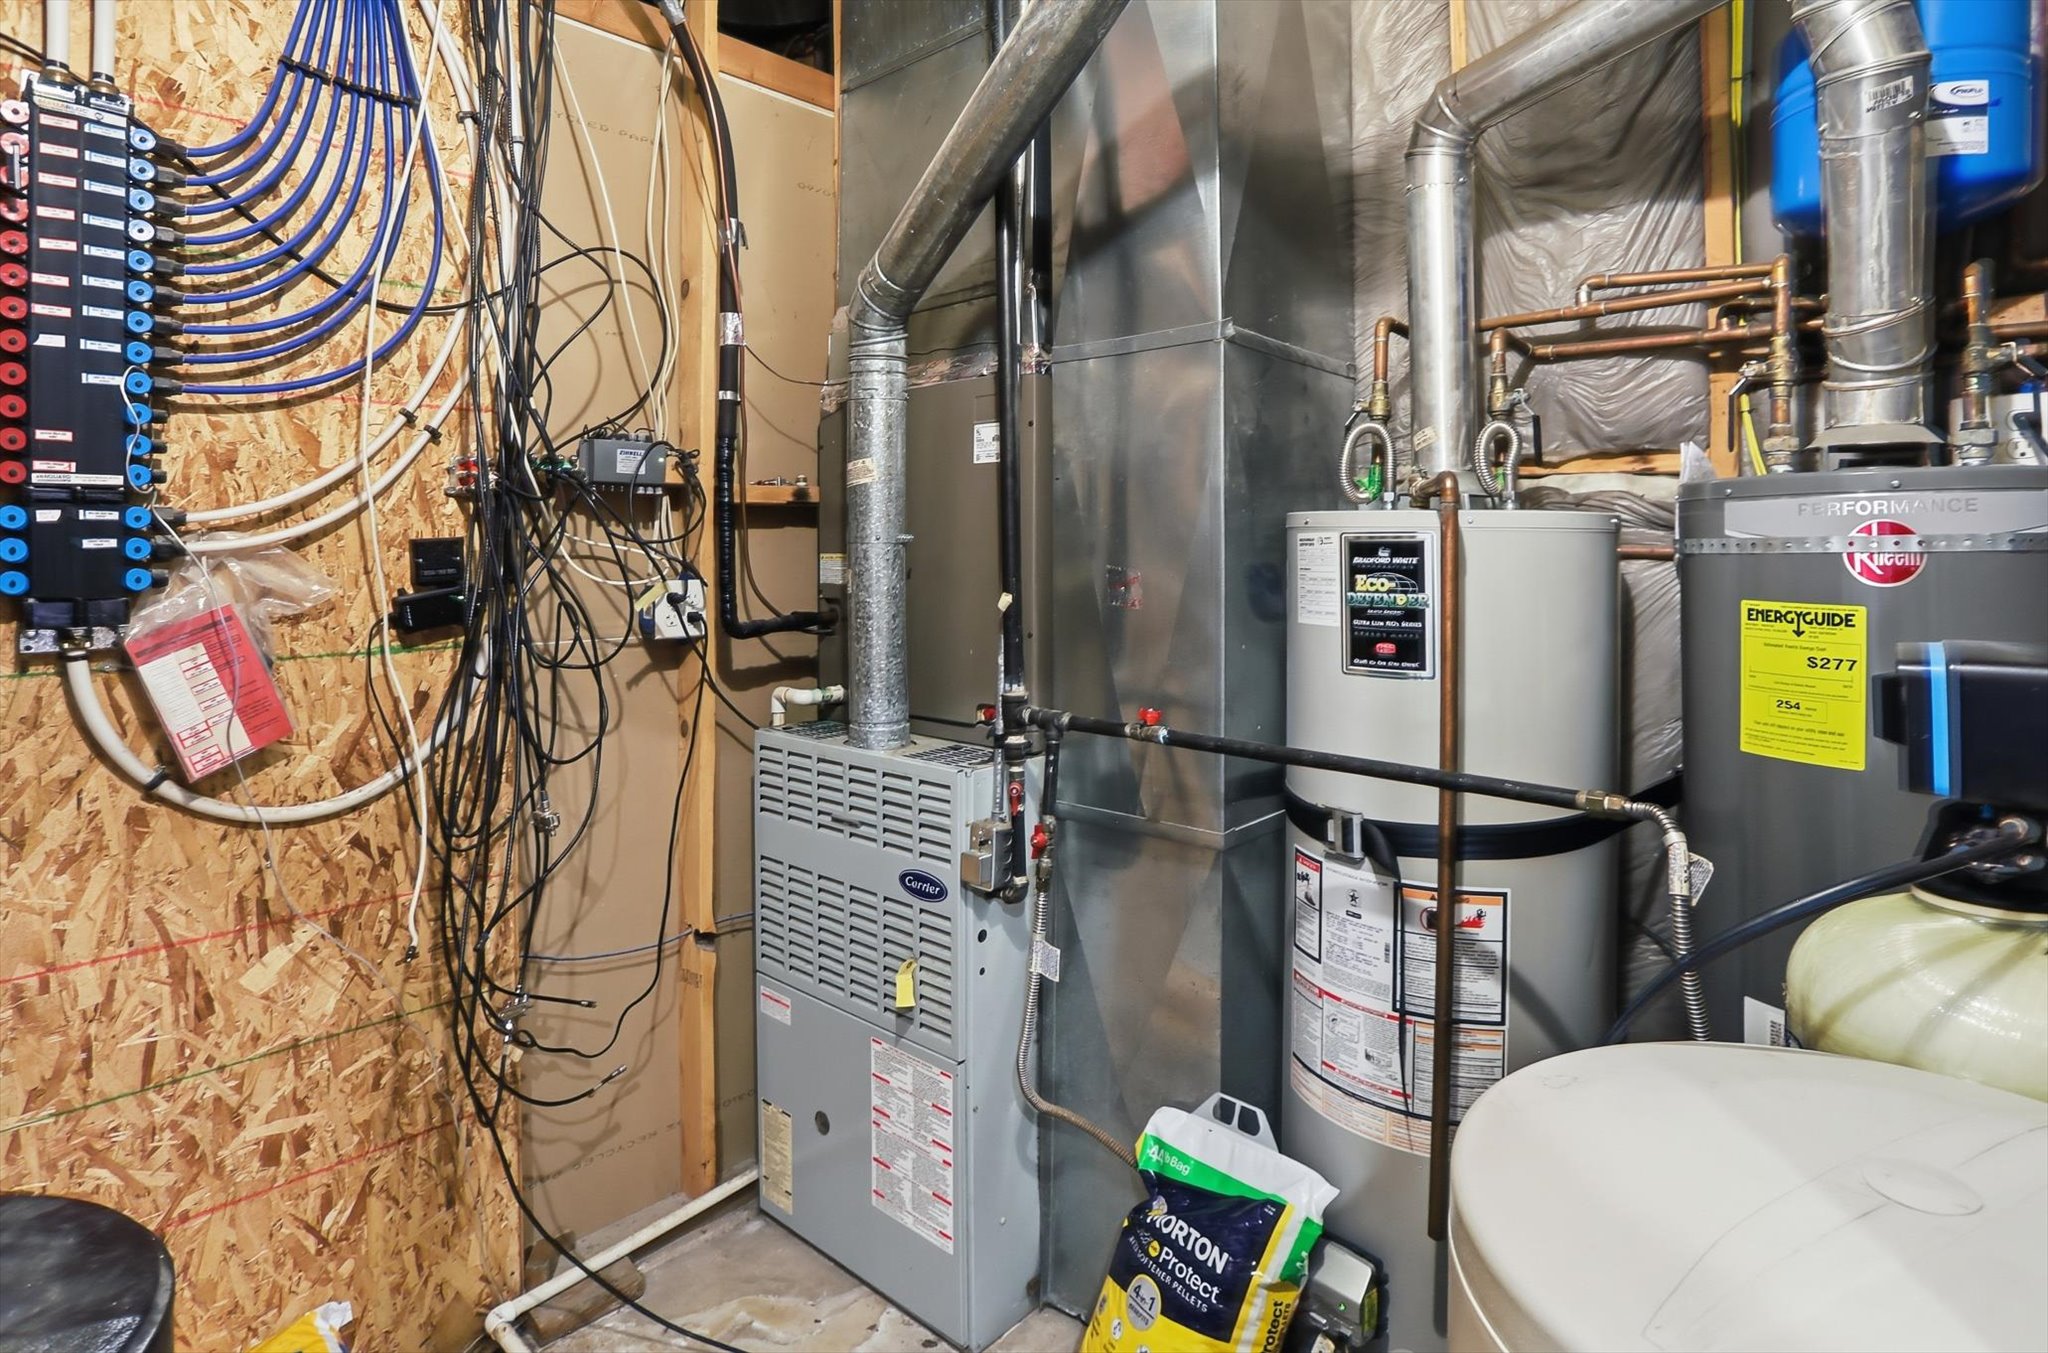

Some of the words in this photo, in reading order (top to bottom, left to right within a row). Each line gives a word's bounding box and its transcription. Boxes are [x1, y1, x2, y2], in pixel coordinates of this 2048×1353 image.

[1798, 497, 1978, 516] PERFORMANCE
[1346, 592, 1430, 609] DEFENDER
[1747, 607, 1856, 629] ENERGYGUIDE
[1776, 699, 1801, 711] 254
[905, 876, 940, 895] Carrier
[1158, 1246, 1220, 1305] Protect
[1263, 1300, 1284, 1353] rotect
